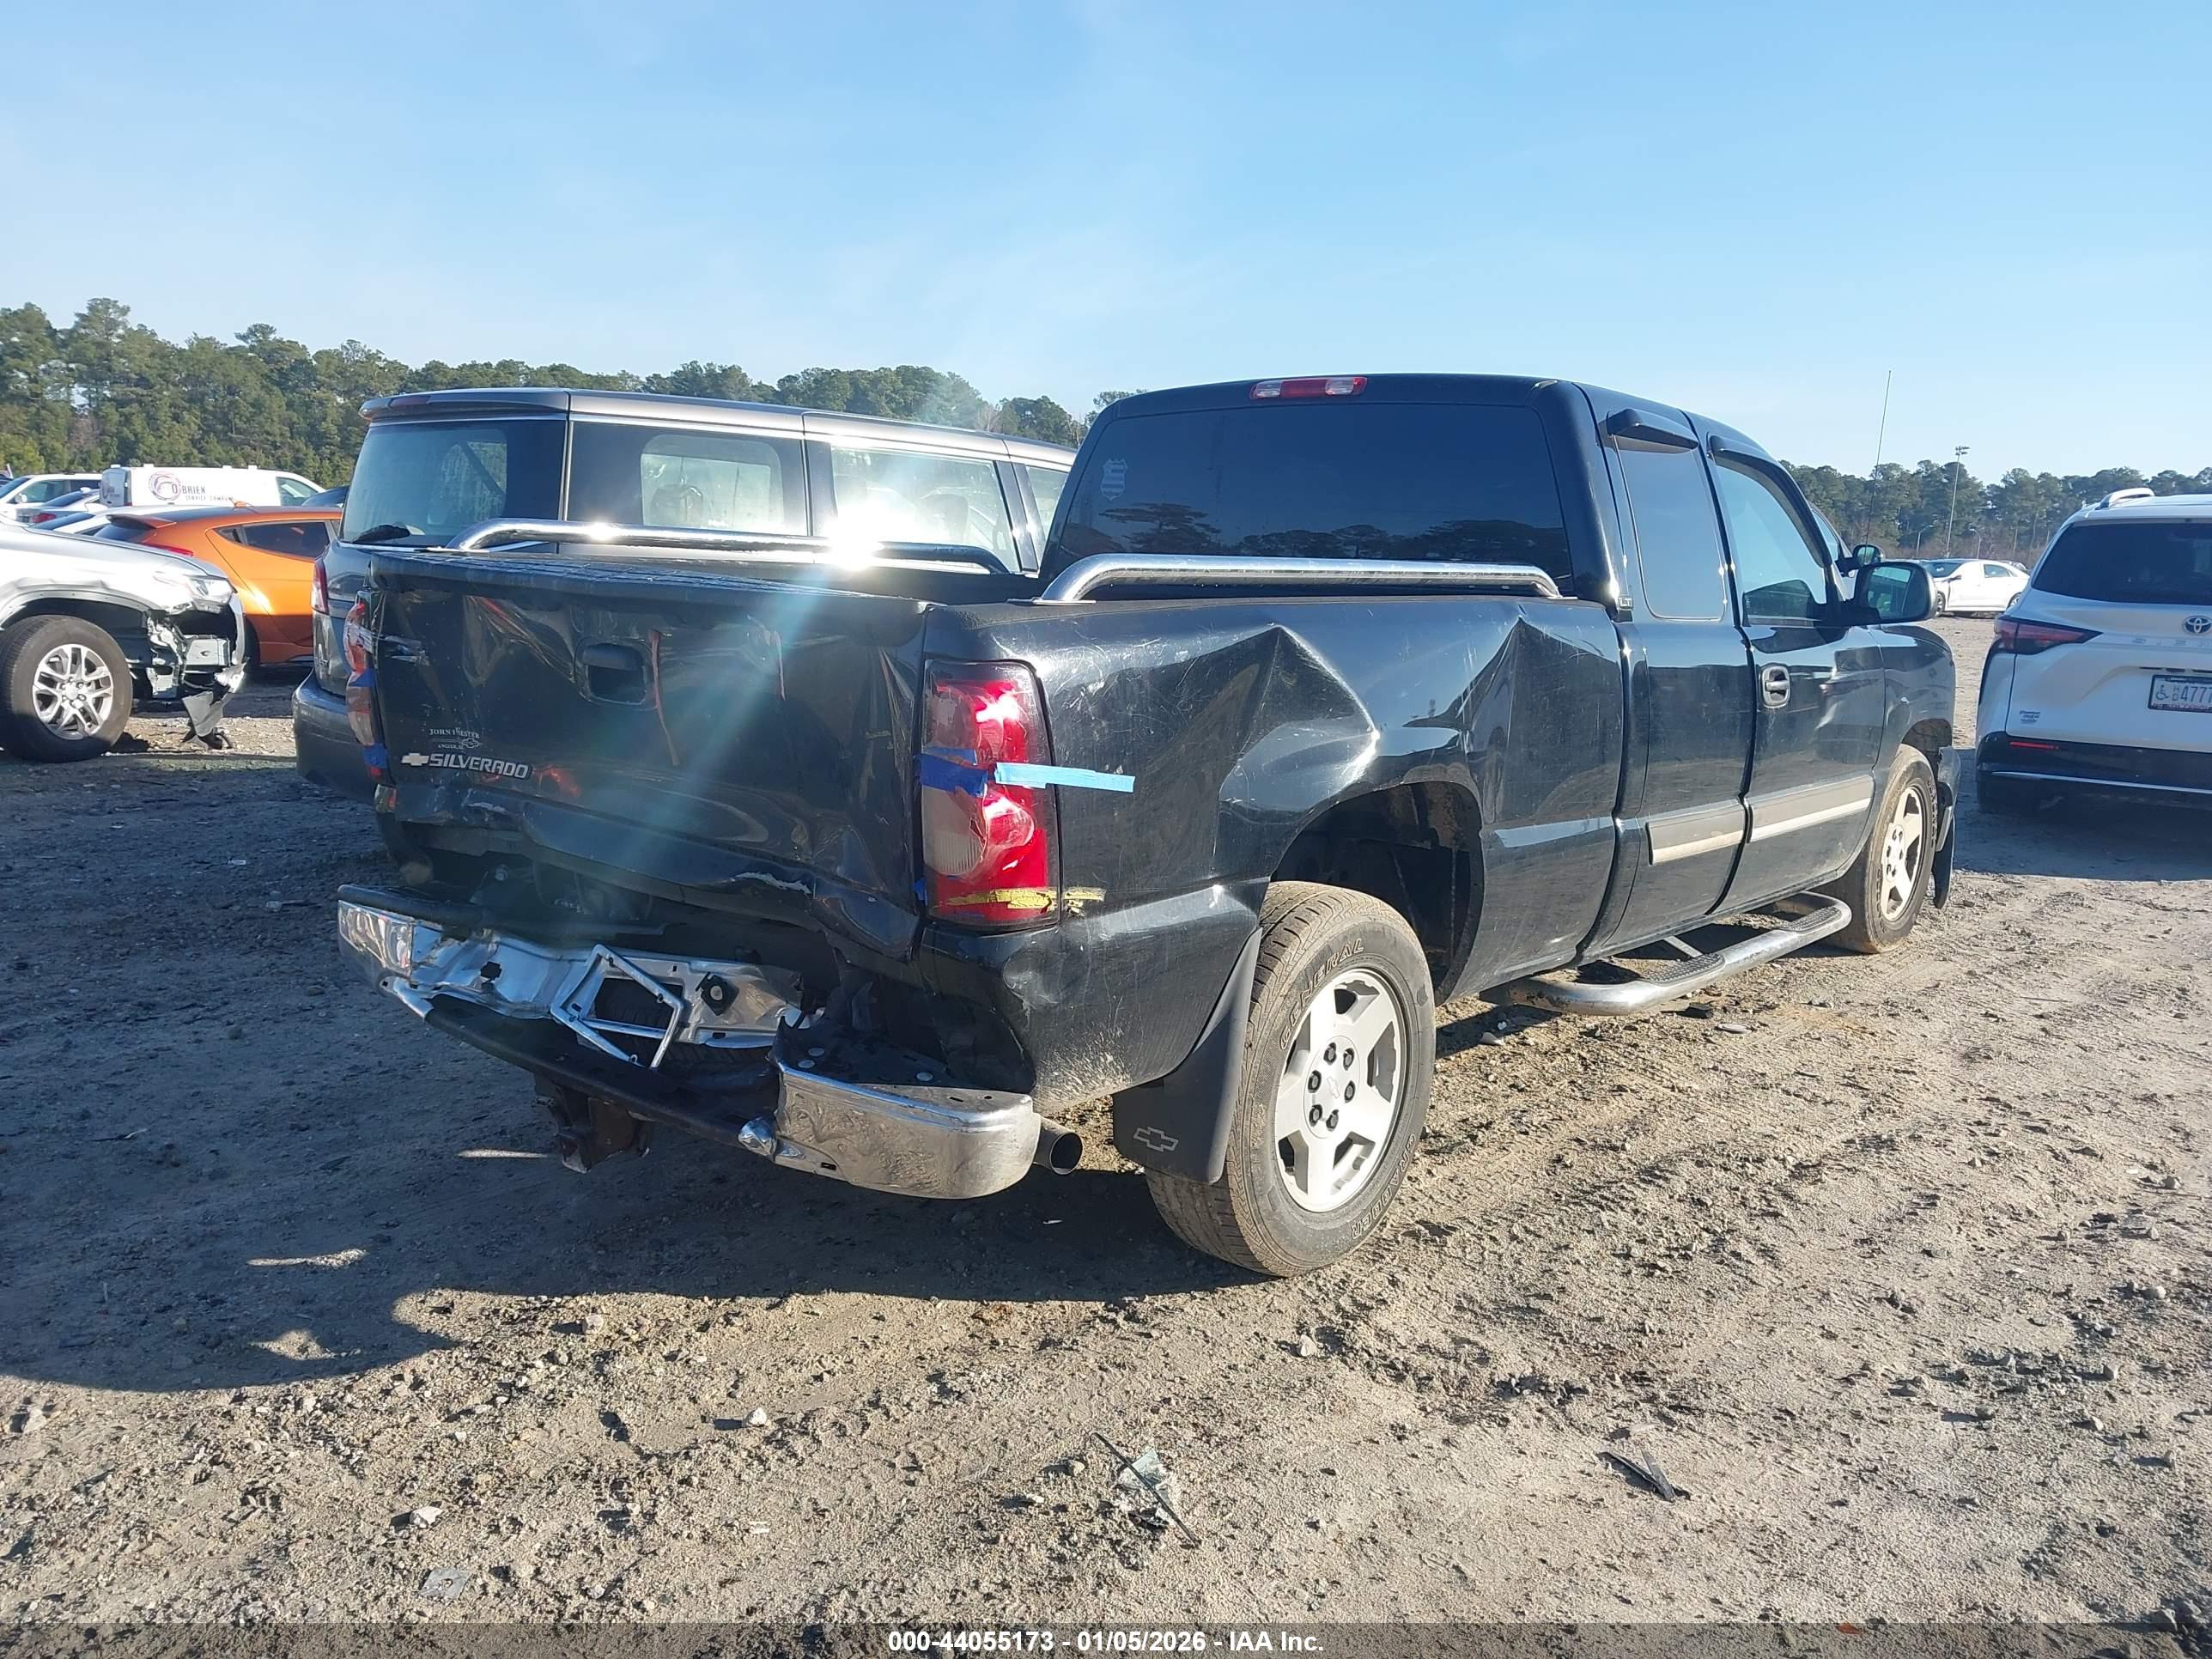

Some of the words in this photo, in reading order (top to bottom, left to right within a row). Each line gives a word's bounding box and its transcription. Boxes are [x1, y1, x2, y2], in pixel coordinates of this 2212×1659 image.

[428, 753, 529, 779] SILVERADO
[1279, 938, 1364, 1050] GENERAL
[1351, 1133, 1416, 1239] GRABBER
